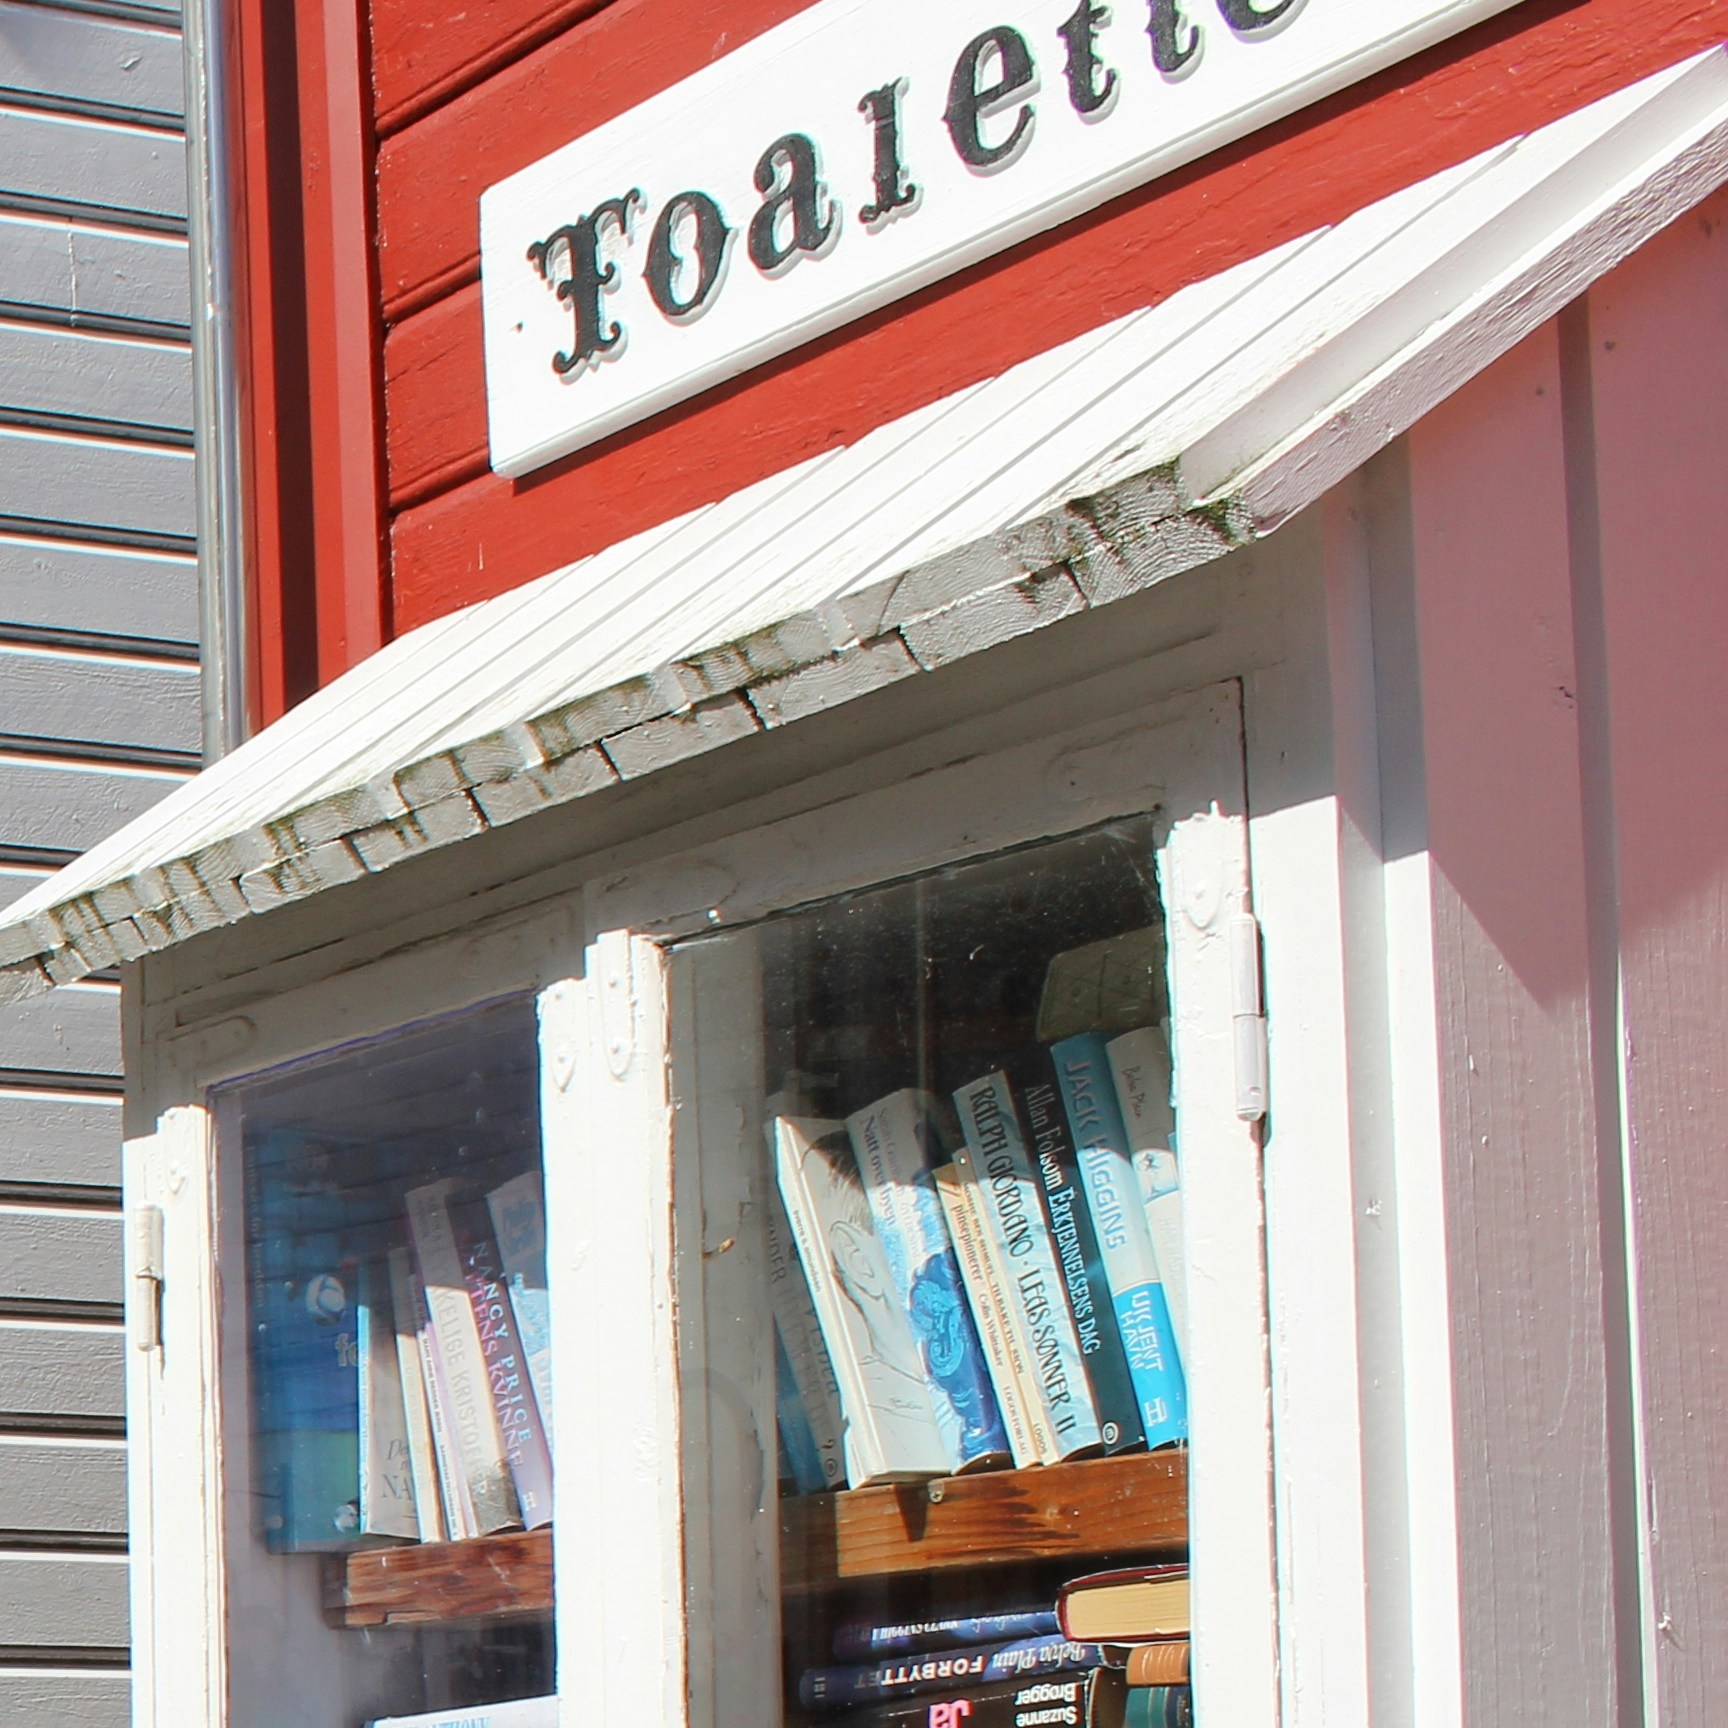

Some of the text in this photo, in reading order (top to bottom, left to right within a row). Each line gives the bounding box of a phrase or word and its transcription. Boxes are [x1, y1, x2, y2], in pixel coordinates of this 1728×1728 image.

[967, 1086, 1010, 1155] RALPH
[1023, 1082, 1058, 1128] Allan
[857, 1116, 883, 1155] Natt
[874, 1185, 901, 1228] byen
[1033, 1126, 1073, 1189] Folsom
[1061, 1057, 1130, 1252] JACK HIGGINS
[984, 1153, 1037, 1258] GIORDANO
[950, 1203, 985, 1283] pinsepionerer
[1015, 1268, 1054, 1328] LEAS
[1127, 1290, 1164, 1374] UKJENT
[472, 1241, 533, 1443] NANCY PRICE
[1029, 1323, 1073, 1409] SØNNER
[1075, 1319, 1104, 1355] DAG
[1117, 1309, 1146, 1370] HAVN
[851, 1640, 1086, 1690] Belva Plain FORBYTTET
